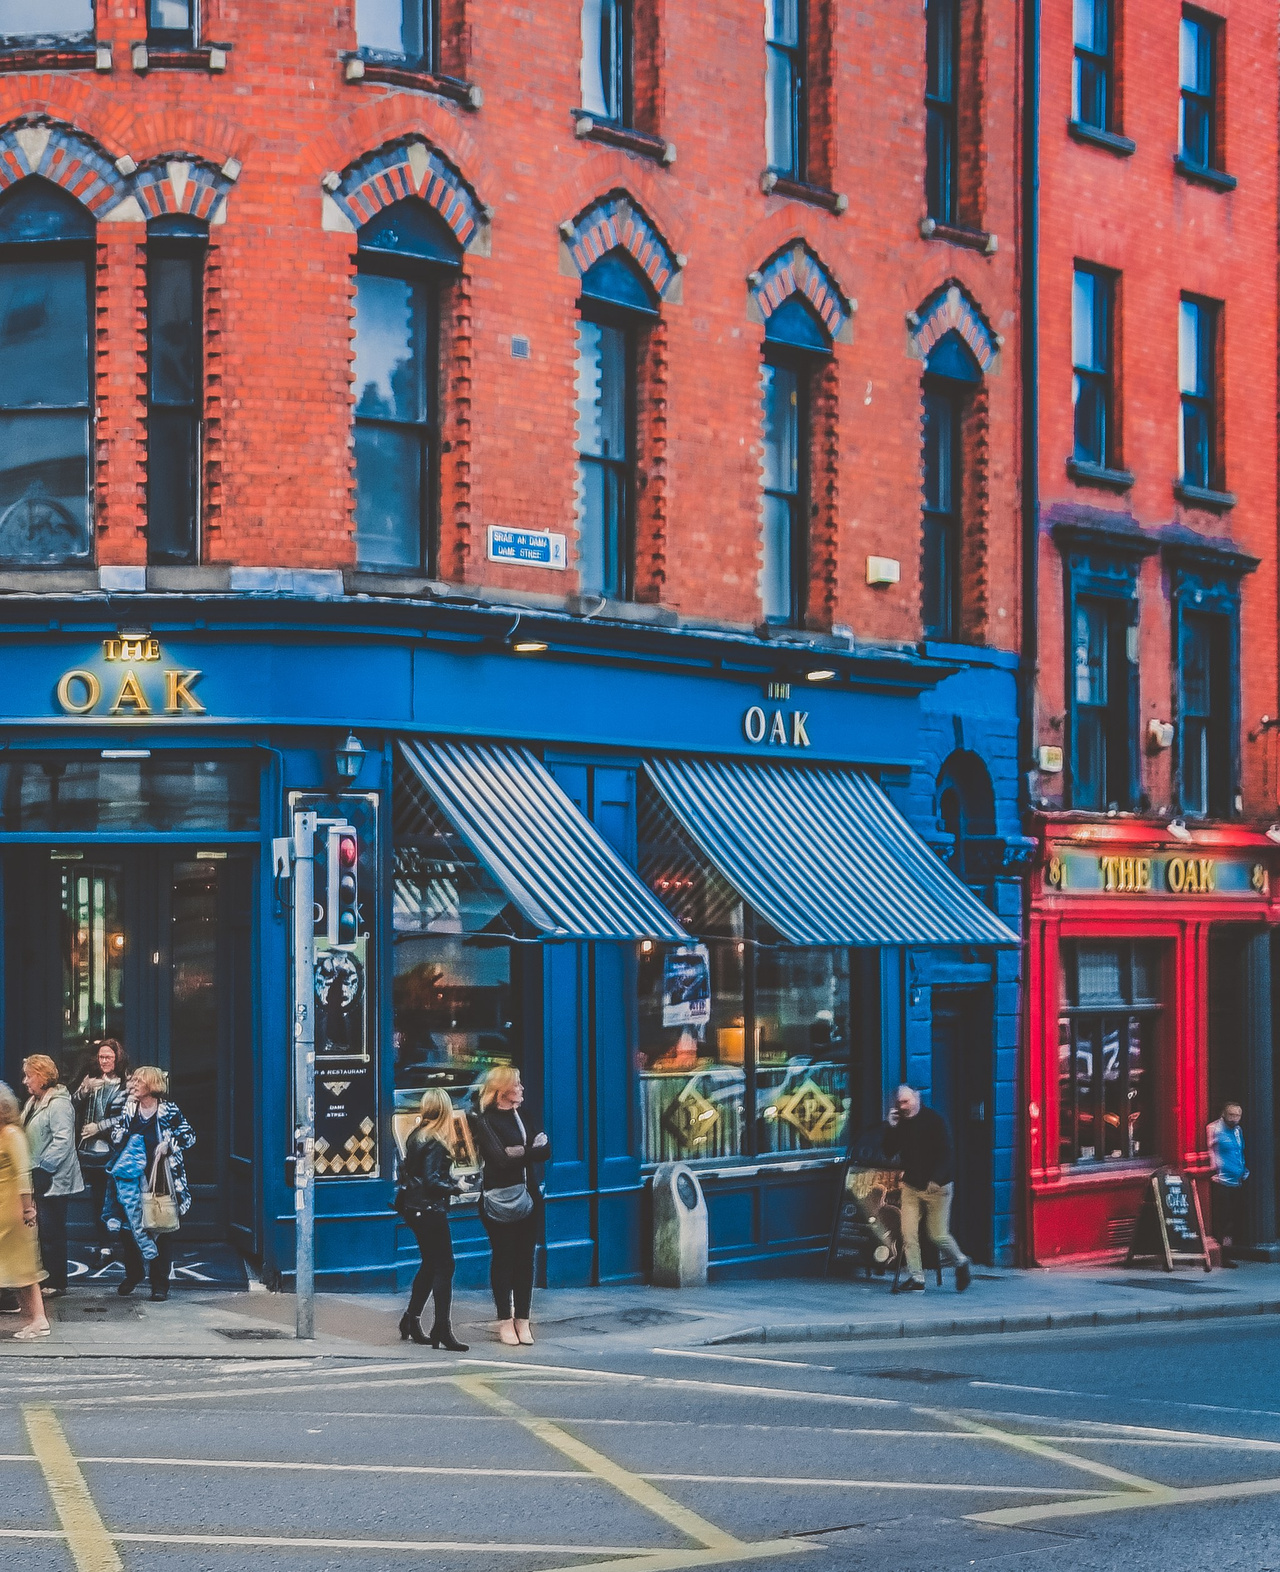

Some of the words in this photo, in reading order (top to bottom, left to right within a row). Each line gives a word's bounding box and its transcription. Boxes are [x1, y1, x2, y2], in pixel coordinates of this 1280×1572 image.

[498, 545, 516, 556] DAME
[519, 548, 545, 559] STREET
[554, 544, 561, 558] 2
[103, 639, 160, 661] THE
[57, 669, 207, 712] OAK
[745, 706, 811, 746] OAK
[1049, 856, 1067, 889] 81
[1101, 856, 1151, 892] THE
[1168, 857, 1216, 893] OAK
[1253, 863, 1269, 894] 81
[326, 1068, 367, 1076] RESTAURANT
